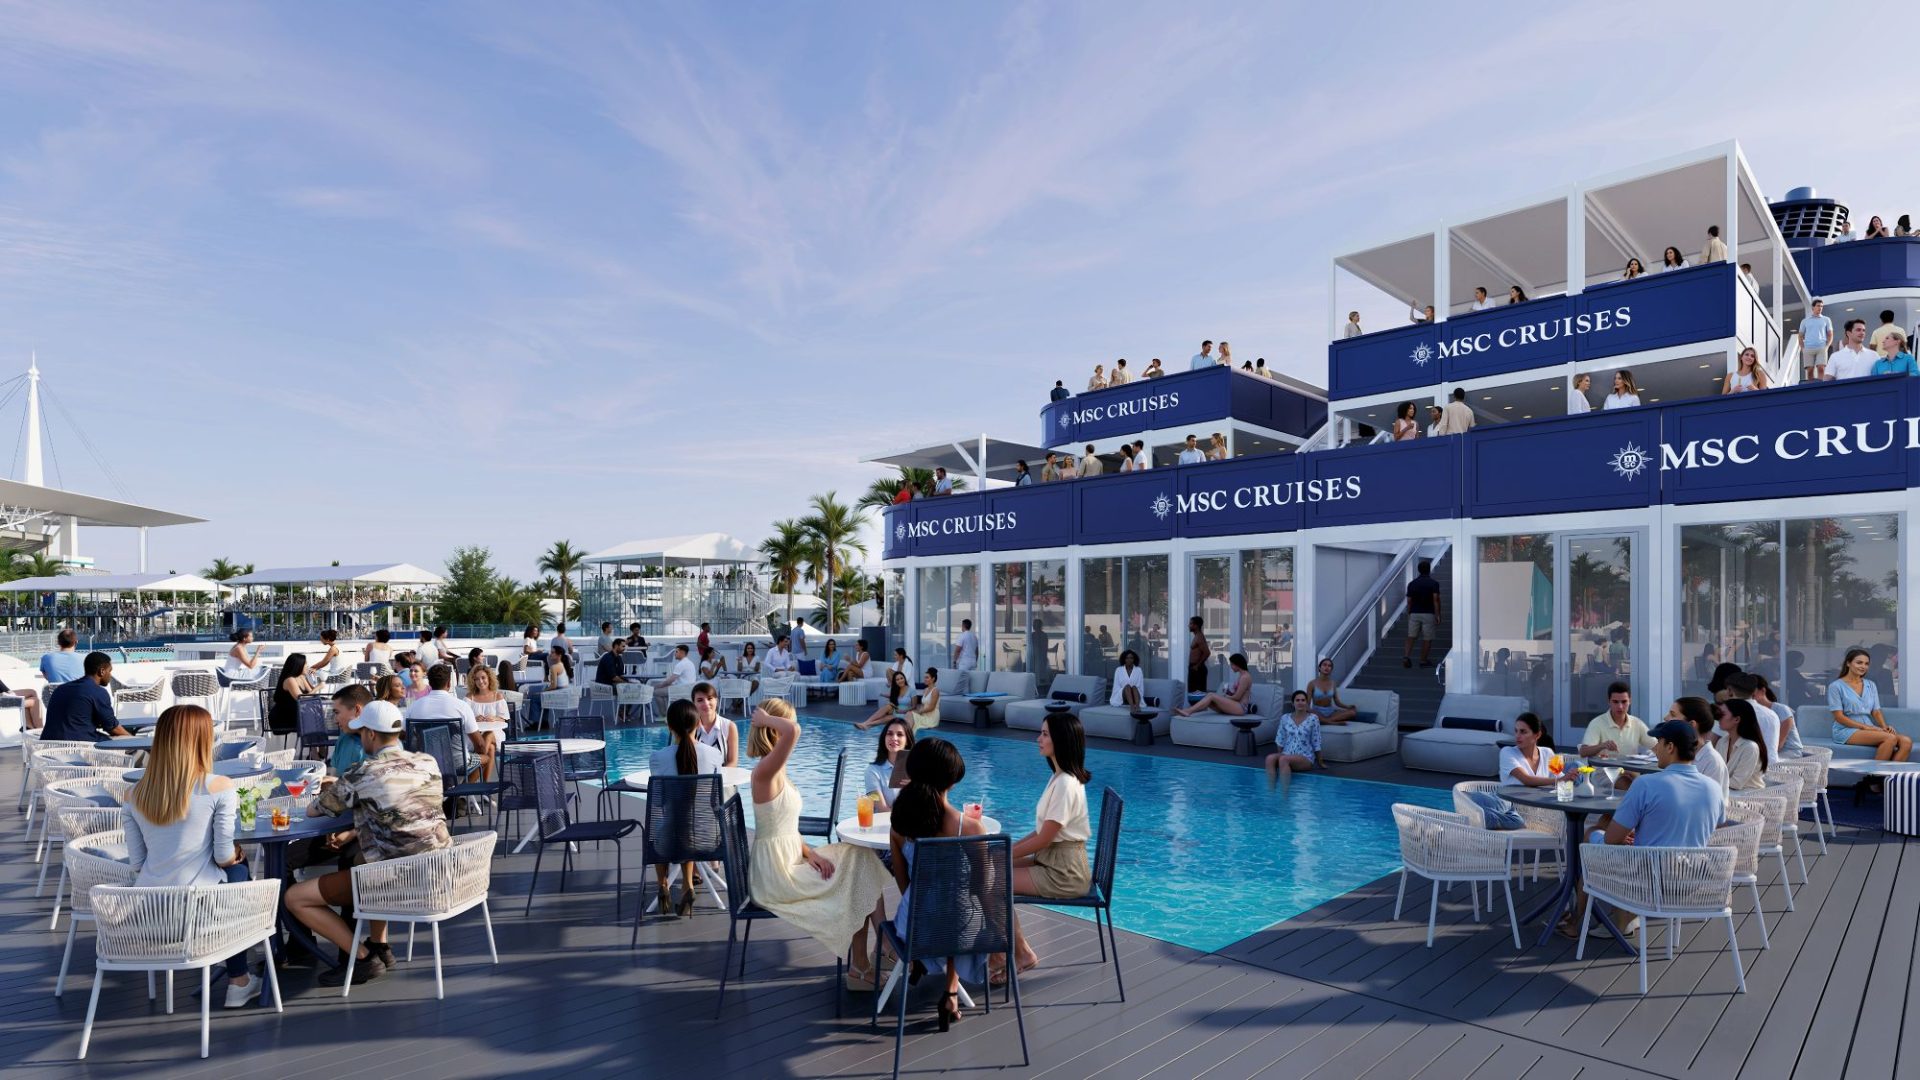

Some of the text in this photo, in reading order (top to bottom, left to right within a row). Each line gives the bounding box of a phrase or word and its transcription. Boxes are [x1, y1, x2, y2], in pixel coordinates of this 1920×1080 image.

[1436, 306, 1632, 360] MSC CRUISES
[1072, 392, 1180, 425] MSC CRUISES
[1659, 434, 1760, 473] MSC
[1175, 475, 1362, 514] MSC CRUISES
[907, 511, 1017, 538] MSC CRUISES
